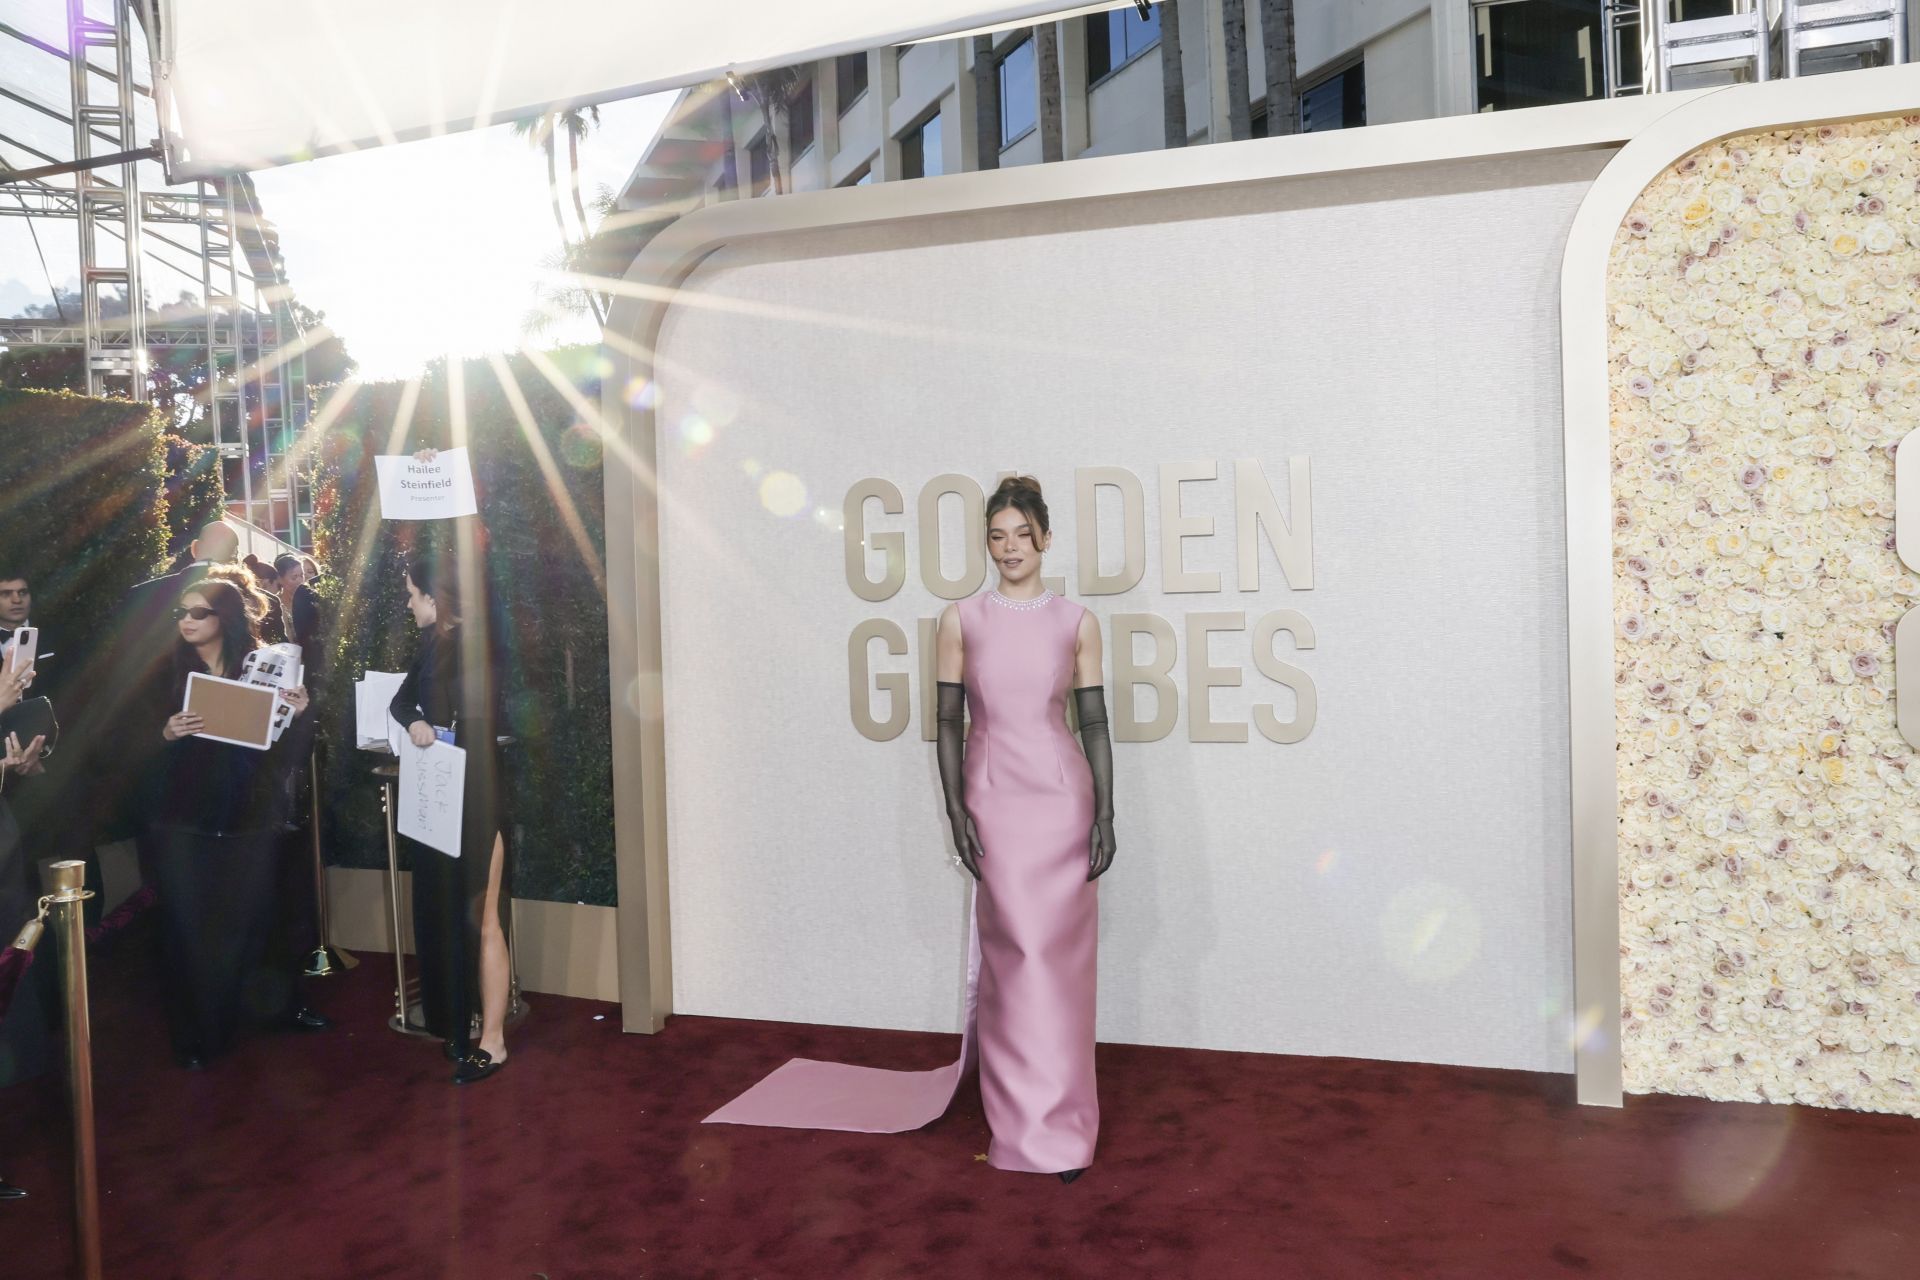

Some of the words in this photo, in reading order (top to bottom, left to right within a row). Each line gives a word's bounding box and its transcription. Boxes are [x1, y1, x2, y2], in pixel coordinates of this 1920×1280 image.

[407, 464, 441, 474] Hailee
[400, 476, 452, 490] Steinfield
[410, 494, 445, 502] Presenter
[843, 456, 1315, 602] GODEN
[847, 608, 1318, 744] GLBES
